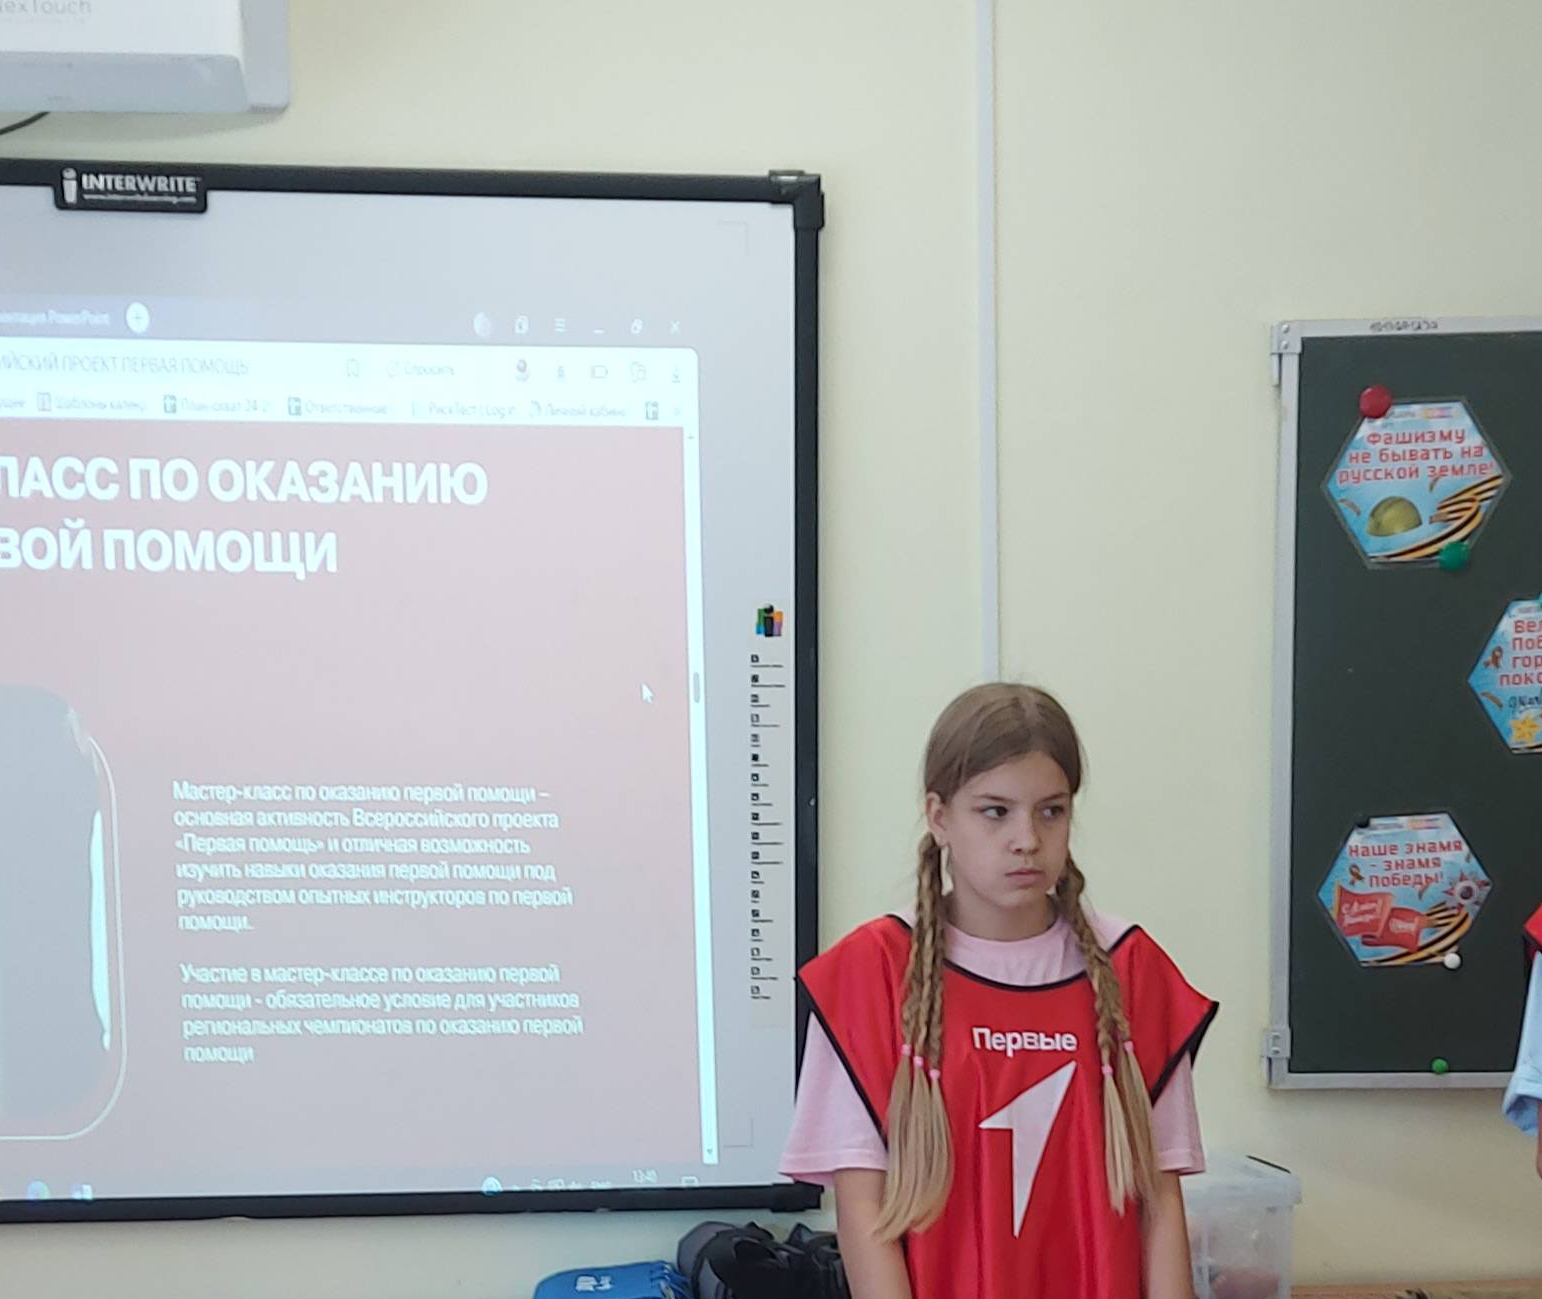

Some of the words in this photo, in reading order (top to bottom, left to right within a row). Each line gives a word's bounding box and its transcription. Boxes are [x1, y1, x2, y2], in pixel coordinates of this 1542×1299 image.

[81, 173, 197, 193] INTERWRITE
[62, 355, 118, 374] ПРОЕКТ
[122, 356, 178, 375] ПЕРВАЯ
[181, 357, 250, 377] ПОМОЩЬ
[1366, 429, 1466, 445] Фашизму
[1348, 452, 1371, 464] не
[1379, 447, 1453, 462] бывать
[1460, 445, 1484, 458] на
[129, 460, 198, 502] ПО
[208, 459, 489, 505] ОКАЗАНИЮ
[1338, 464, 1419, 485] русской
[104, 527, 338, 581] ПОМОЩИ
[1349, 844, 1399, 857] Наше
[1405, 840, 1463, 854] знамя
[1383, 857, 1441, 871] знамя
[970, 1025, 1078, 1057] Первые
